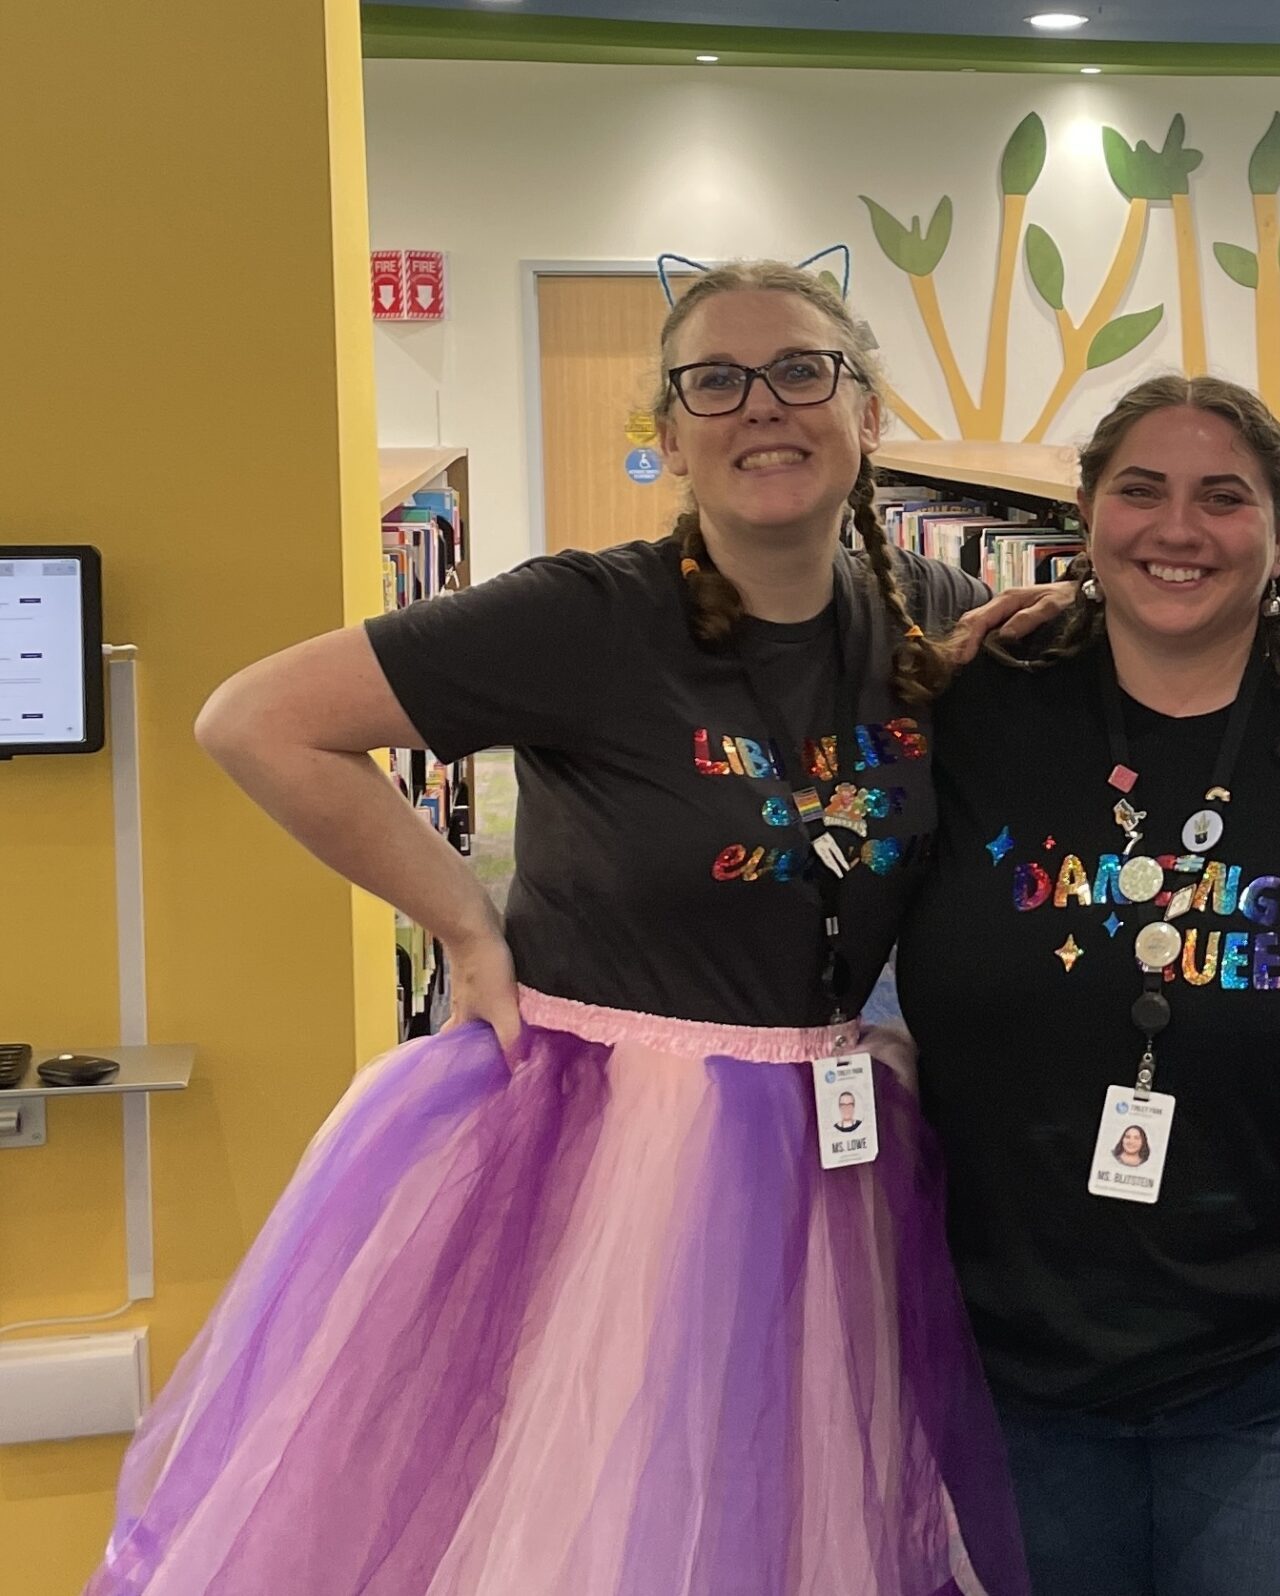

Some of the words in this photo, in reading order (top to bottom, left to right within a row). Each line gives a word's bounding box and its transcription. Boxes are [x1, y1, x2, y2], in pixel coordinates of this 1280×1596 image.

[374, 260, 397, 273] FIRE
[412, 260, 437, 273] FIRE
[831, 1141, 846, 1154] MS.
[847, 1137, 868, 1151] LOWE
